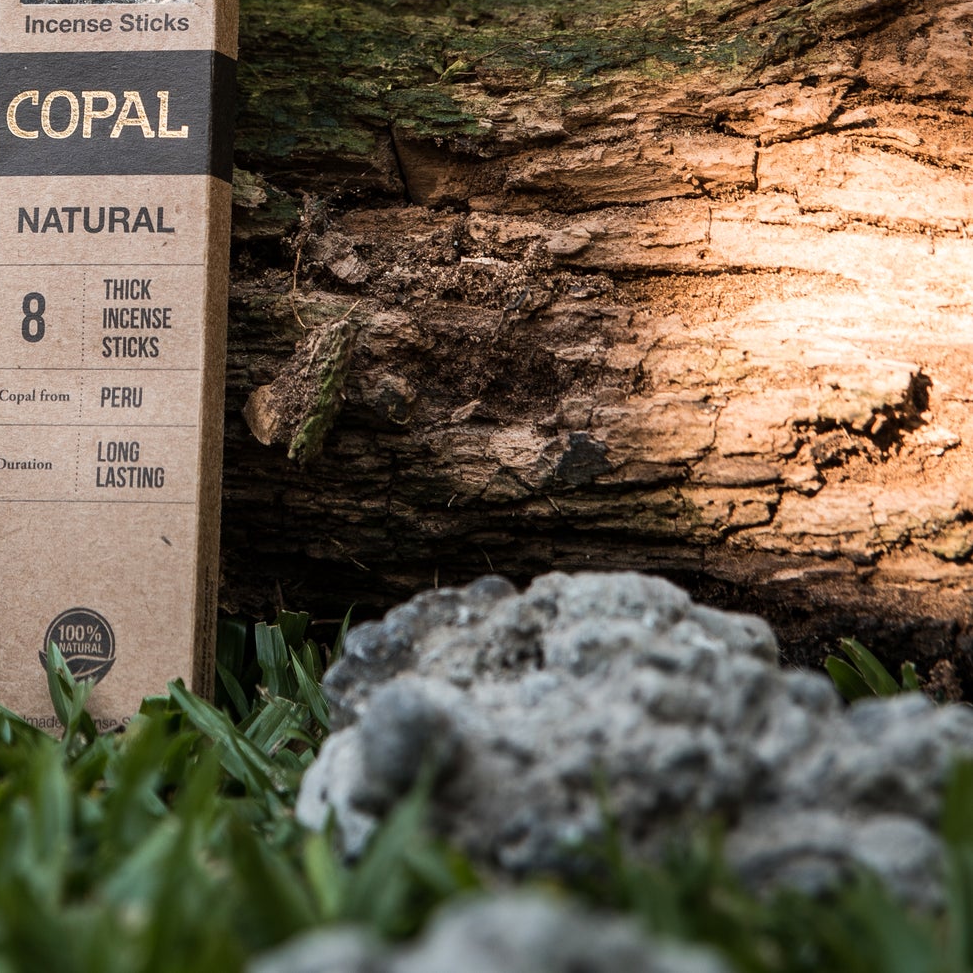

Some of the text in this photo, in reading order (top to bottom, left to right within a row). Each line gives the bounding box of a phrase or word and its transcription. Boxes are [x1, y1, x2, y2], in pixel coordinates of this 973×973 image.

[25, 13, 190, 34] Incense Sticks
[6, 90, 189, 140] COPAL
[17, 207, 175, 234] NATURAL
[103, 278, 152, 300] THICK
[21, 292, 46, 343] 8
[102, 308, 172, 329] INCENSE
[101, 336, 160, 358] STICKS
[39, 389, 71, 403] from
[100, 386, 143, 408] PERU
[97, 441, 140, 463] LONG
[95, 466, 165, 489] LASTING
[58, 624, 102, 642] 100%
[58, 642, 103, 654] NATURAL
